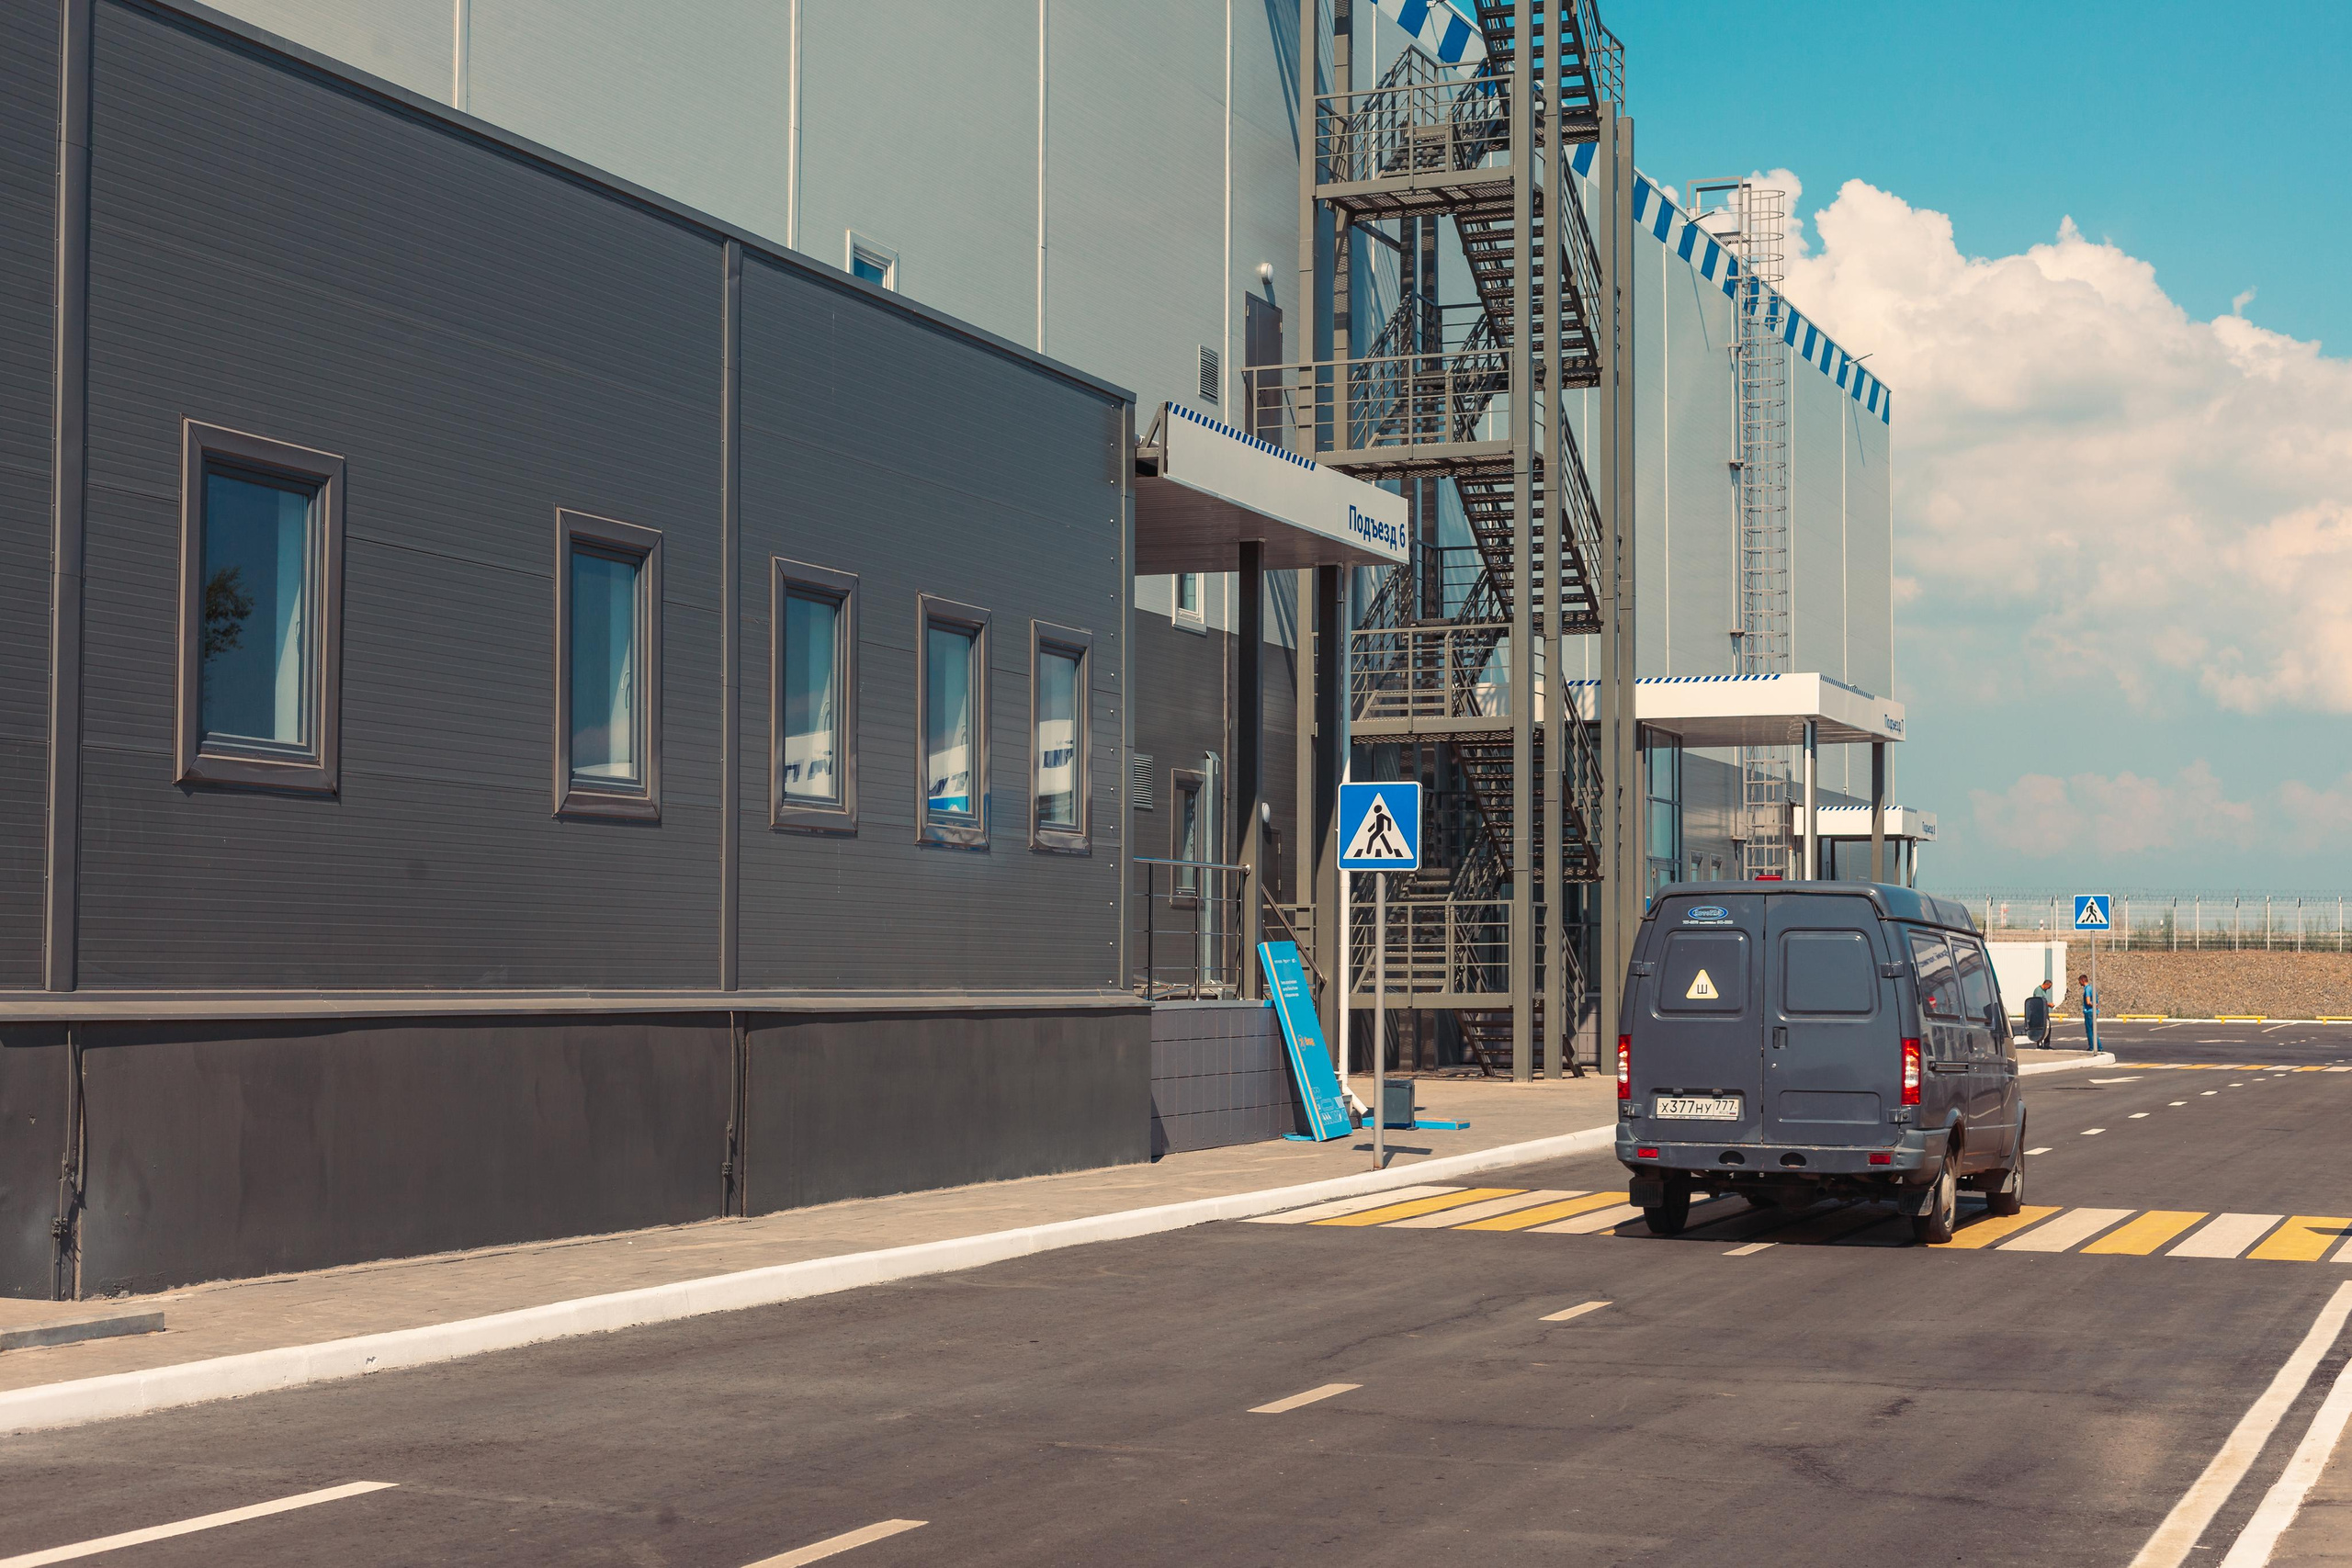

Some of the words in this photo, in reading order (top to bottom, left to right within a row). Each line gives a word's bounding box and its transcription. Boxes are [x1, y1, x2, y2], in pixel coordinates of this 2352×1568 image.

[1349, 504, 1397, 551] Подъезд
[1399, 523, 1406, 548] 6
[1697, 984, 1707, 994] Ш
[1714, 1100, 1735, 1111] 777
